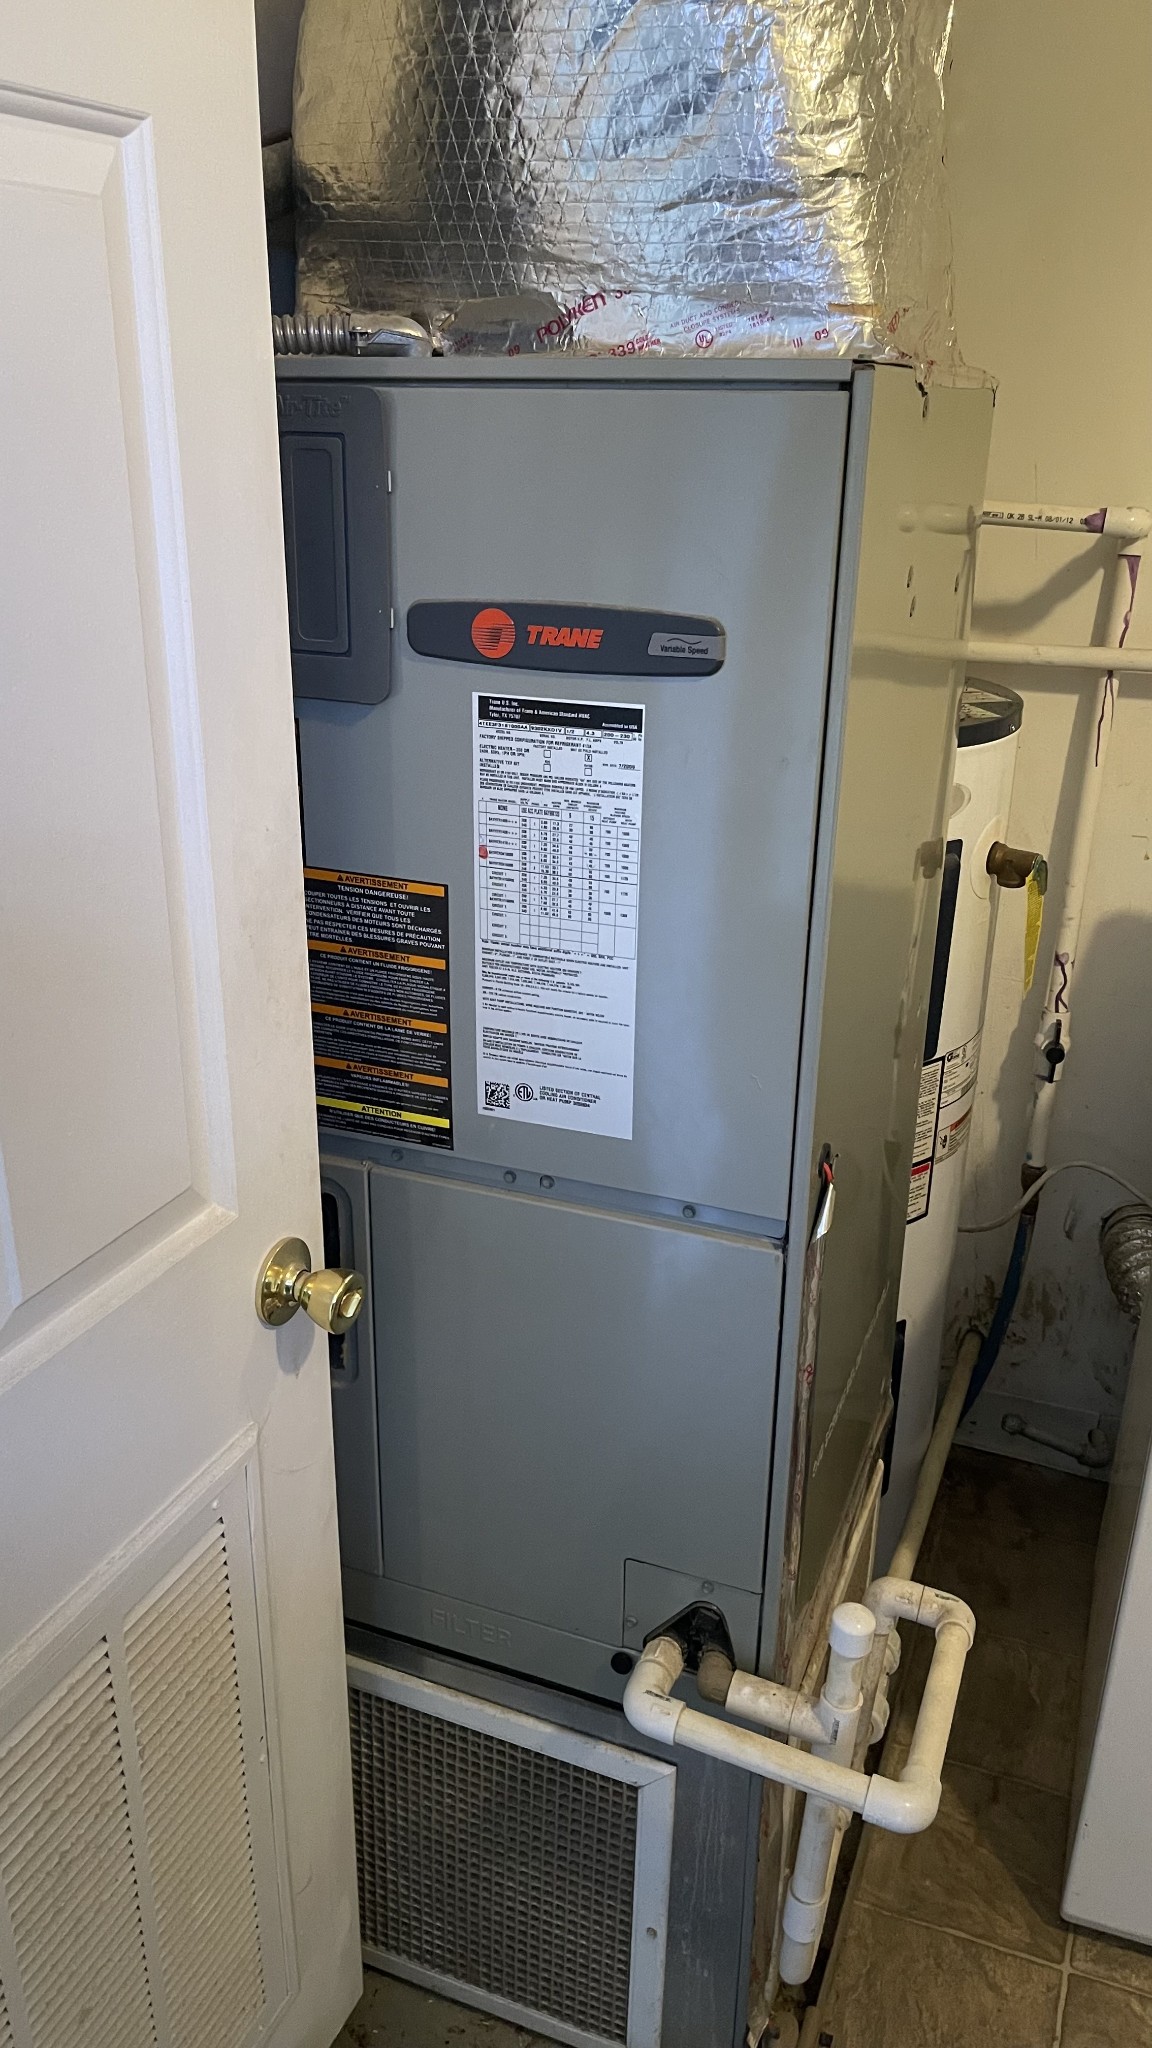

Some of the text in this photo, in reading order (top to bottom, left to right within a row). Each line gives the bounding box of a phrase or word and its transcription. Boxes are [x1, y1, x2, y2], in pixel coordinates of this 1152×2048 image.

[536, 291, 606, 344] POLYKEN
[681, 314, 698, 326] DUCT
[700, 310, 712, 320] AND
[683, 318, 710, 334] CLOSURE
[526, 625, 604, 650] TRANE
[660, 644, 708, 655] Variable Speed
[345, 875, 408, 890] AVERTISSEMENT
[327, 893, 348, 901] TOUTES
[338, 885, 408, 900] TENSION DANGEREUSE!
[306, 904, 343, 913] NTERVENTION.
[307, 910, 351, 921] ONDENSATEURS
[364, 919, 390, 927] MOTEURS
[325, 920, 356, 930] RESPECTER
[369, 928, 396, 936] MESURES
[321, 933, 352, 942] MORTELLES
[363, 933, 396, 943] BLESSURES
[348, 947, 410, 962] AVERTISSEMENT
[351, 1010, 412, 1026] AVERTISSEMENT
[353, 1064, 414, 1080] AVERTISSEMENT
[568, 1095, 596, 1104] CONDITIONER
[362, 1106, 402, 1118] ATTENTION
[375, 1117, 409, 1127] CONDUCTEURS
[430, 1608, 512, 1647] FILTER
